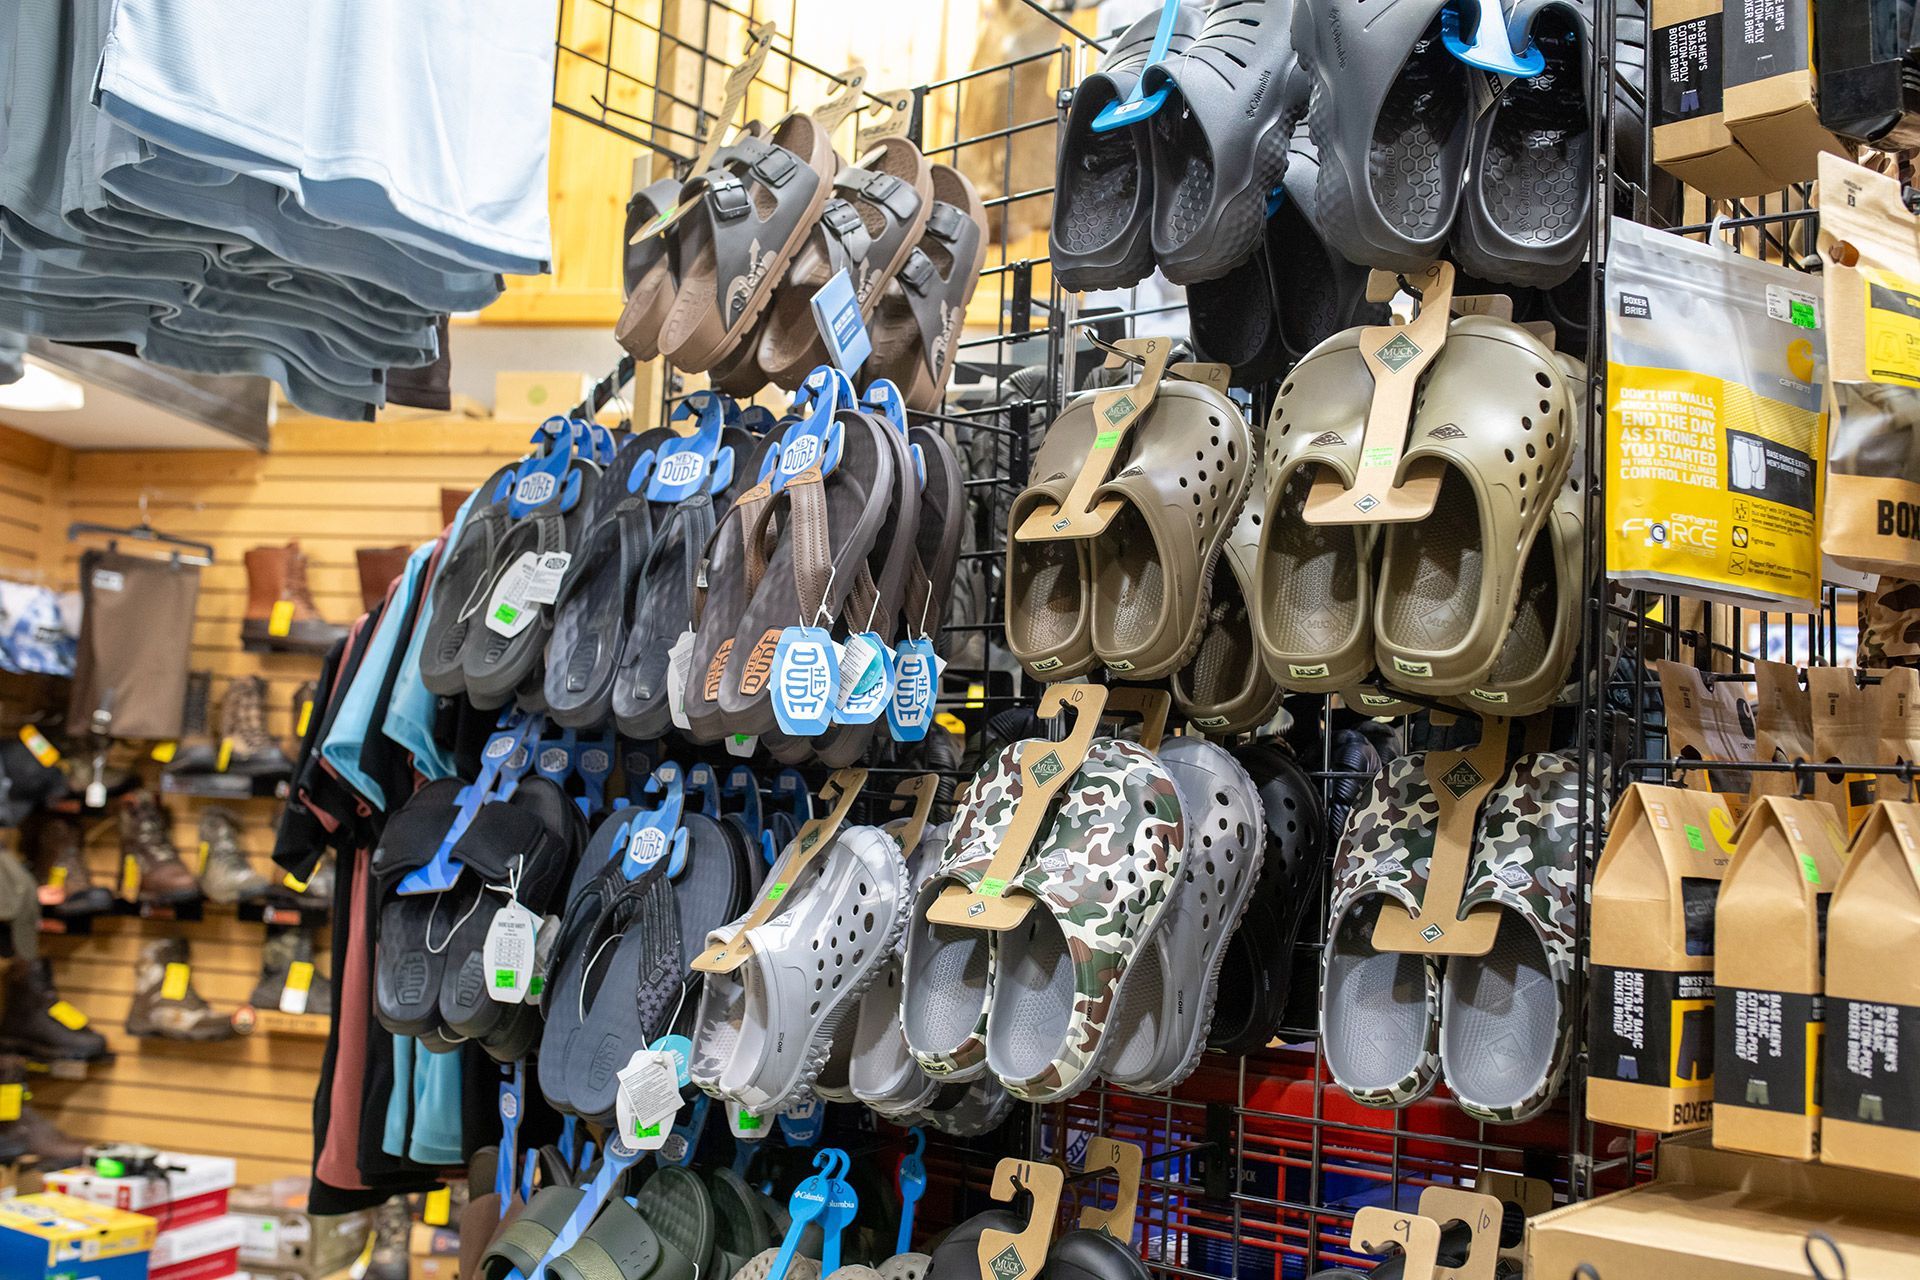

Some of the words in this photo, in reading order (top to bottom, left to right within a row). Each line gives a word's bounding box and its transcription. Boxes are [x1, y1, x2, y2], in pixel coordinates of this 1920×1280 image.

[1765, 0, 1774, 21] ASIC
[1775, 5, 1785, 32] MEN'S
[1669, 27, 1679, 57] BOXER
[1697, 20, 1707, 43] BASE
[1744, 20, 1755, 44] BRIEF
[1688, 34, 1698, 59] BASIC
[1698, 44, 1708, 71] MEN'S
[1669, 58, 1680, 83] BRIEF
[1250, 70, 1271, 110] Columbia
[1426, 266, 1440, 287] 9
[1463, 298, 1477, 312] 11
[1623, 296, 1647, 307] BOXER
[1625, 306, 1648, 316] BRIEF
[1146, 340, 1156, 354] 8
[1383, 347, 1416, 357] MUCK
[1208, 368, 1221, 381] 12
[1620, 388, 1656, 399] DON'T
[1657, 390, 1677, 401] HIT
[1621, 412, 1656, 426] END
[1658, 414, 1688, 430] THE
[1691, 418, 1716, 435] DAY
[795, 438, 811, 449] HEY
[1621, 428, 1641, 441] AS
[1644, 428, 1698, 446] STRONG
[1700, 436, 1716, 451] AS
[674, 454, 693, 464] HEY
[784, 442, 815, 470] DUDE
[1620, 442, 1655, 457] YOU
[1658, 443, 1718, 467] STARTED
[662, 459, 698, 482] DUDE
[1620, 466, 1681, 483] CONTROL
[1682, 472, 1720, 490] LAYER.
[520, 480, 552, 500] DUDE
[744, 635, 780, 691] DUDE
[747, 645, 763, 672] HEY
[784, 648, 817, 717] DUDE
[813, 666, 827, 703] HEY
[898, 660, 923, 721] DUDE
[917, 676, 928, 710] HEY
[1071, 688, 1084, 703] 10
[1035, 763, 1060, 772] MUCK
[1447, 772, 1477, 783] MUCK
[633, 836, 663, 861] DUDE
[1613, 971, 1624, 1004] BOXER
[1634, 972, 1645, 1004] MEN'S
[1736, 991, 1747, 1026] BOXER
[1770, 993, 1782, 1023] BASE
[1613, 1005, 1624, 1037] BRIEF
[1758, 1007, 1769, 1038] BASIC
[1848, 1002, 1860, 1040] BOXER
[1885, 1006, 1899, 1036] BASE
[1632, 1018, 1644, 1050] BASIC
[1736, 1028, 1747, 1060] BRIEF
[1769, 1024, 1782, 1058] MEN'S
[1872, 1019, 1885, 1053] BASIC
[1847, 1040, 1860, 1074] BRIEF
[1884, 1037, 1898, 1072] MEN'S
[1111, 1144, 1121, 1163] 13
[1016, 1163, 1031, 1183] 11
[1394, 1218, 1411, 1243] 9
[1477, 1208, 1491, 1234] 10
[995, 1258, 1020, 1271] MUCK
